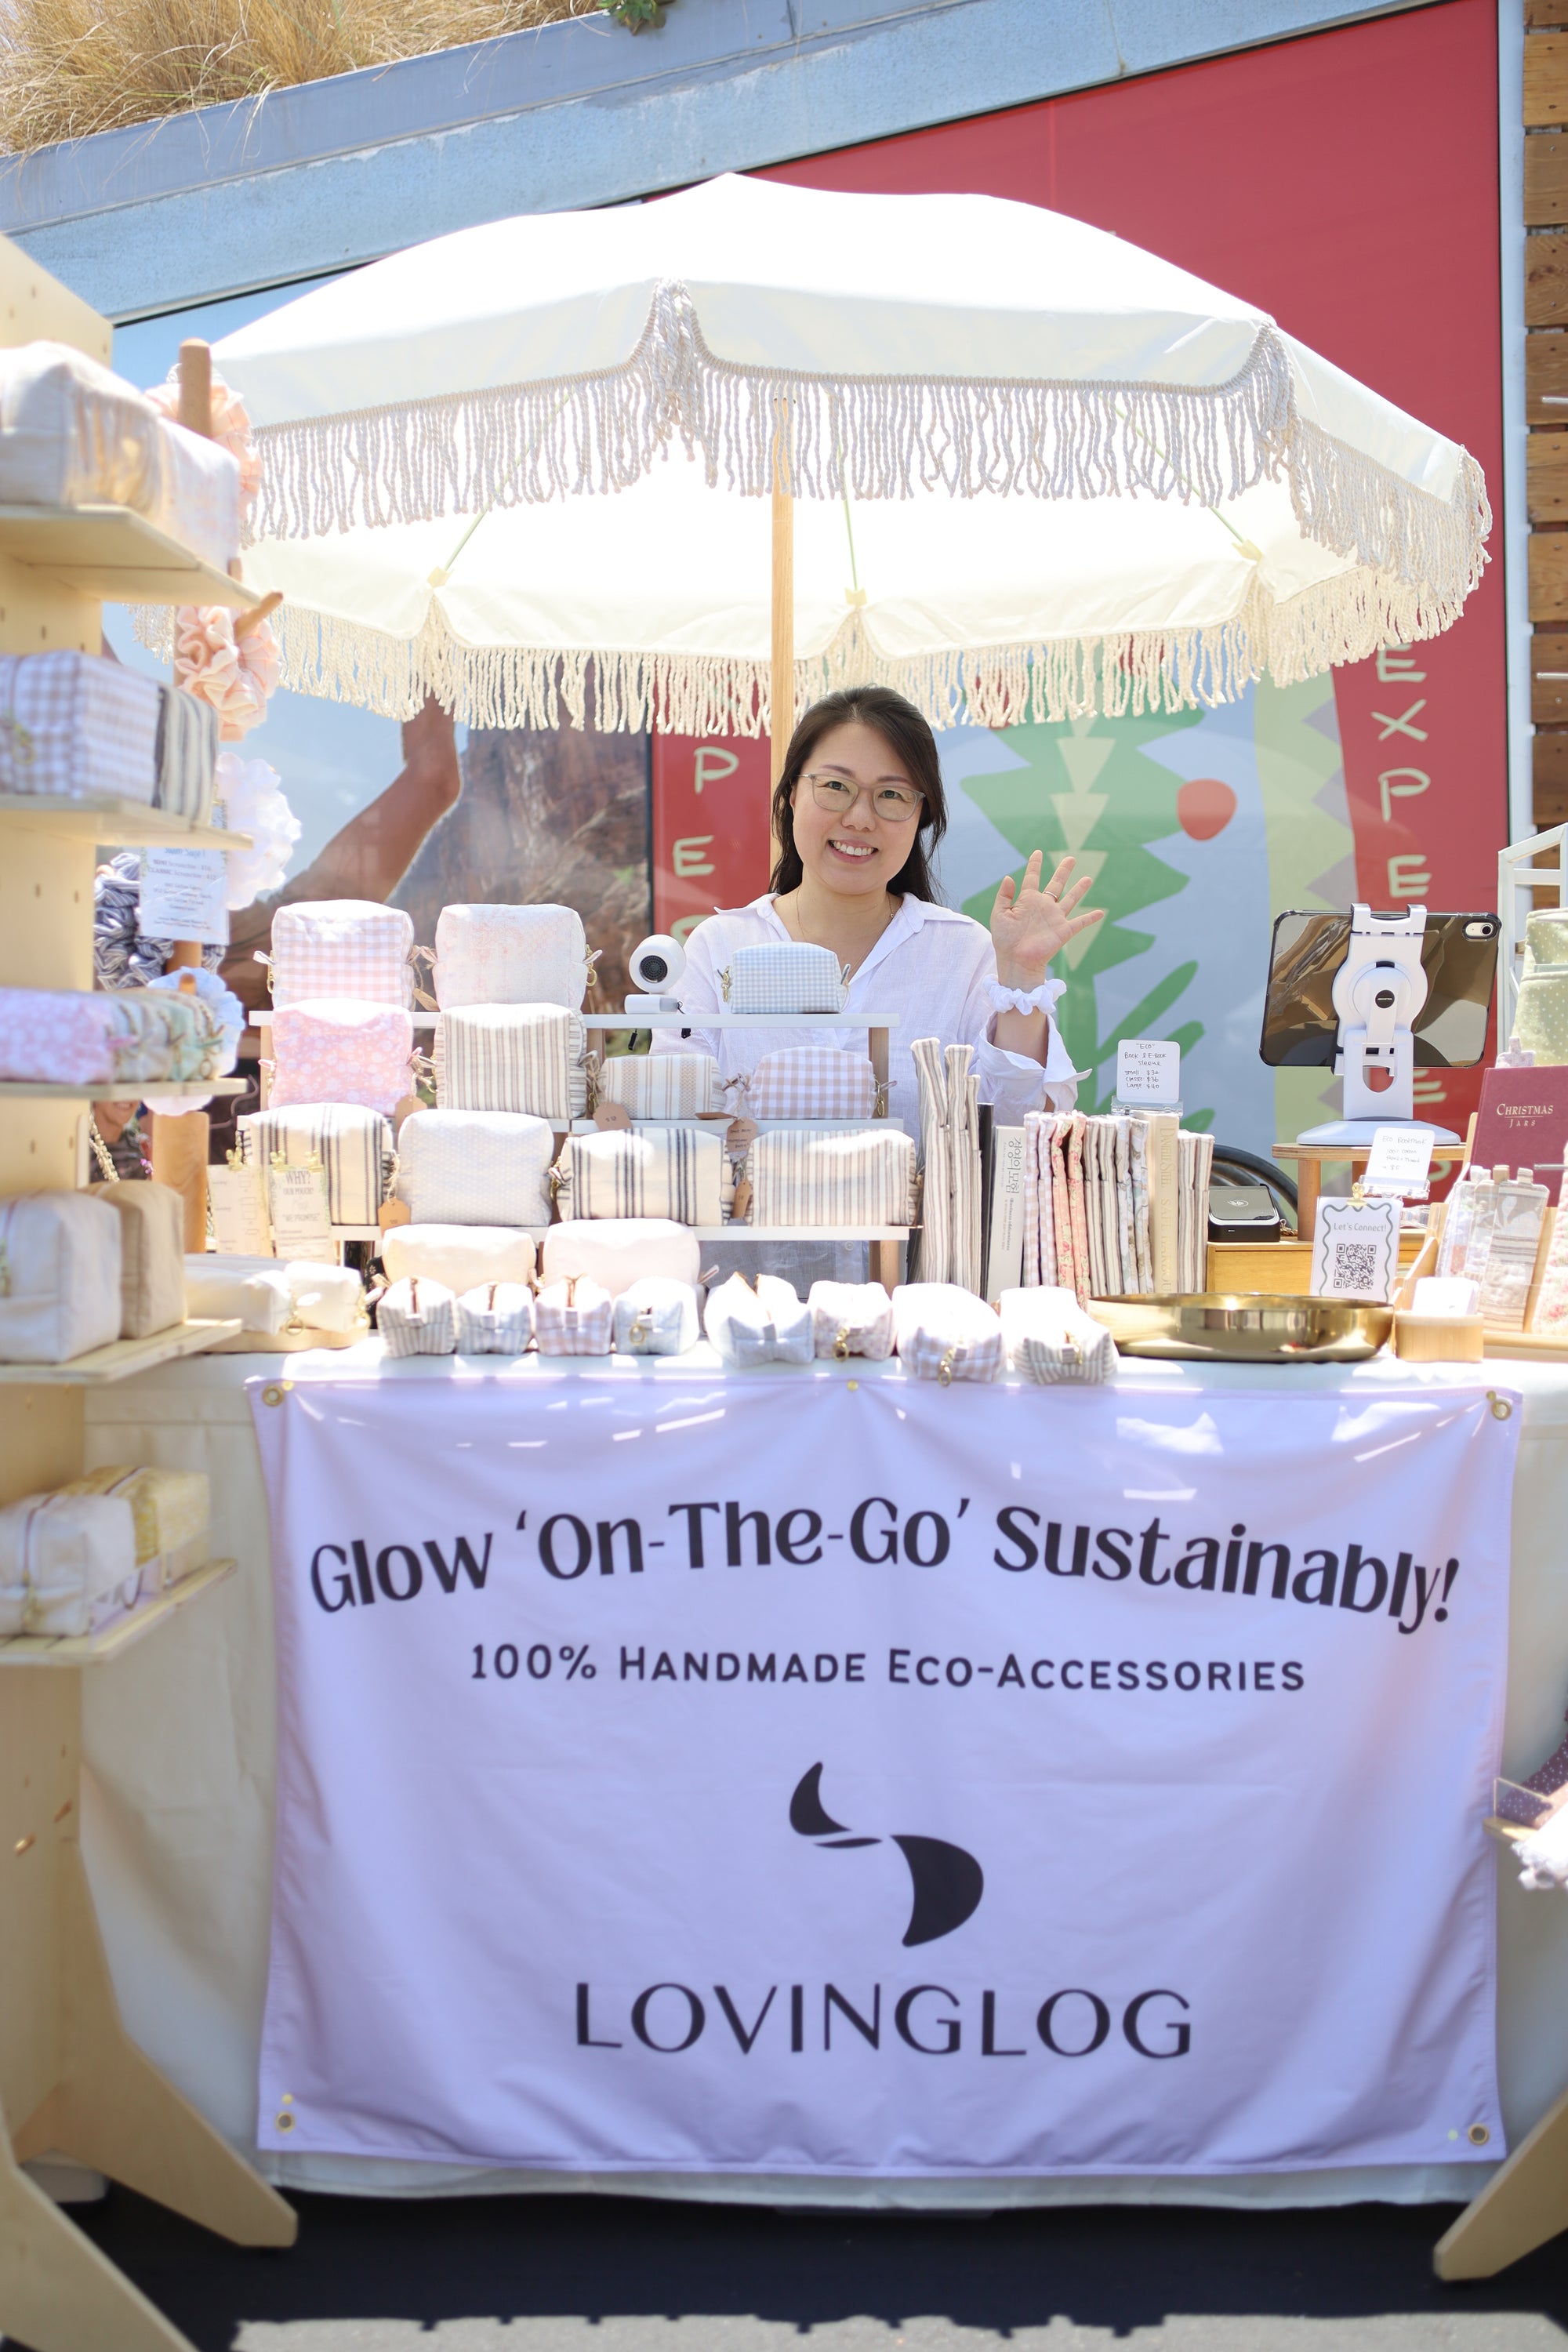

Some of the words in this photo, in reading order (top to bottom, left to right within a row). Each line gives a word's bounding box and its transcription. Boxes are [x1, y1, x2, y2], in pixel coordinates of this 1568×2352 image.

[1496, 1102, 1554, 1116] CHRISTMAS
[1508, 1118, 1537, 1129] JARS
[1007, 1136, 1023, 1171] 경영의
[1006, 1171, 1020, 1194] 모험
[1334, 1222, 1352, 1231] Let's
[1354, 1223, 1387, 1232] Connect!
[993, 1505, 1460, 1635] Sustainably!
[470, 1643, 597, 1680] 100%
[619, 1645, 866, 1683] HANDMADE
[576, 1981, 1192, 2060] LOVINGLOG
